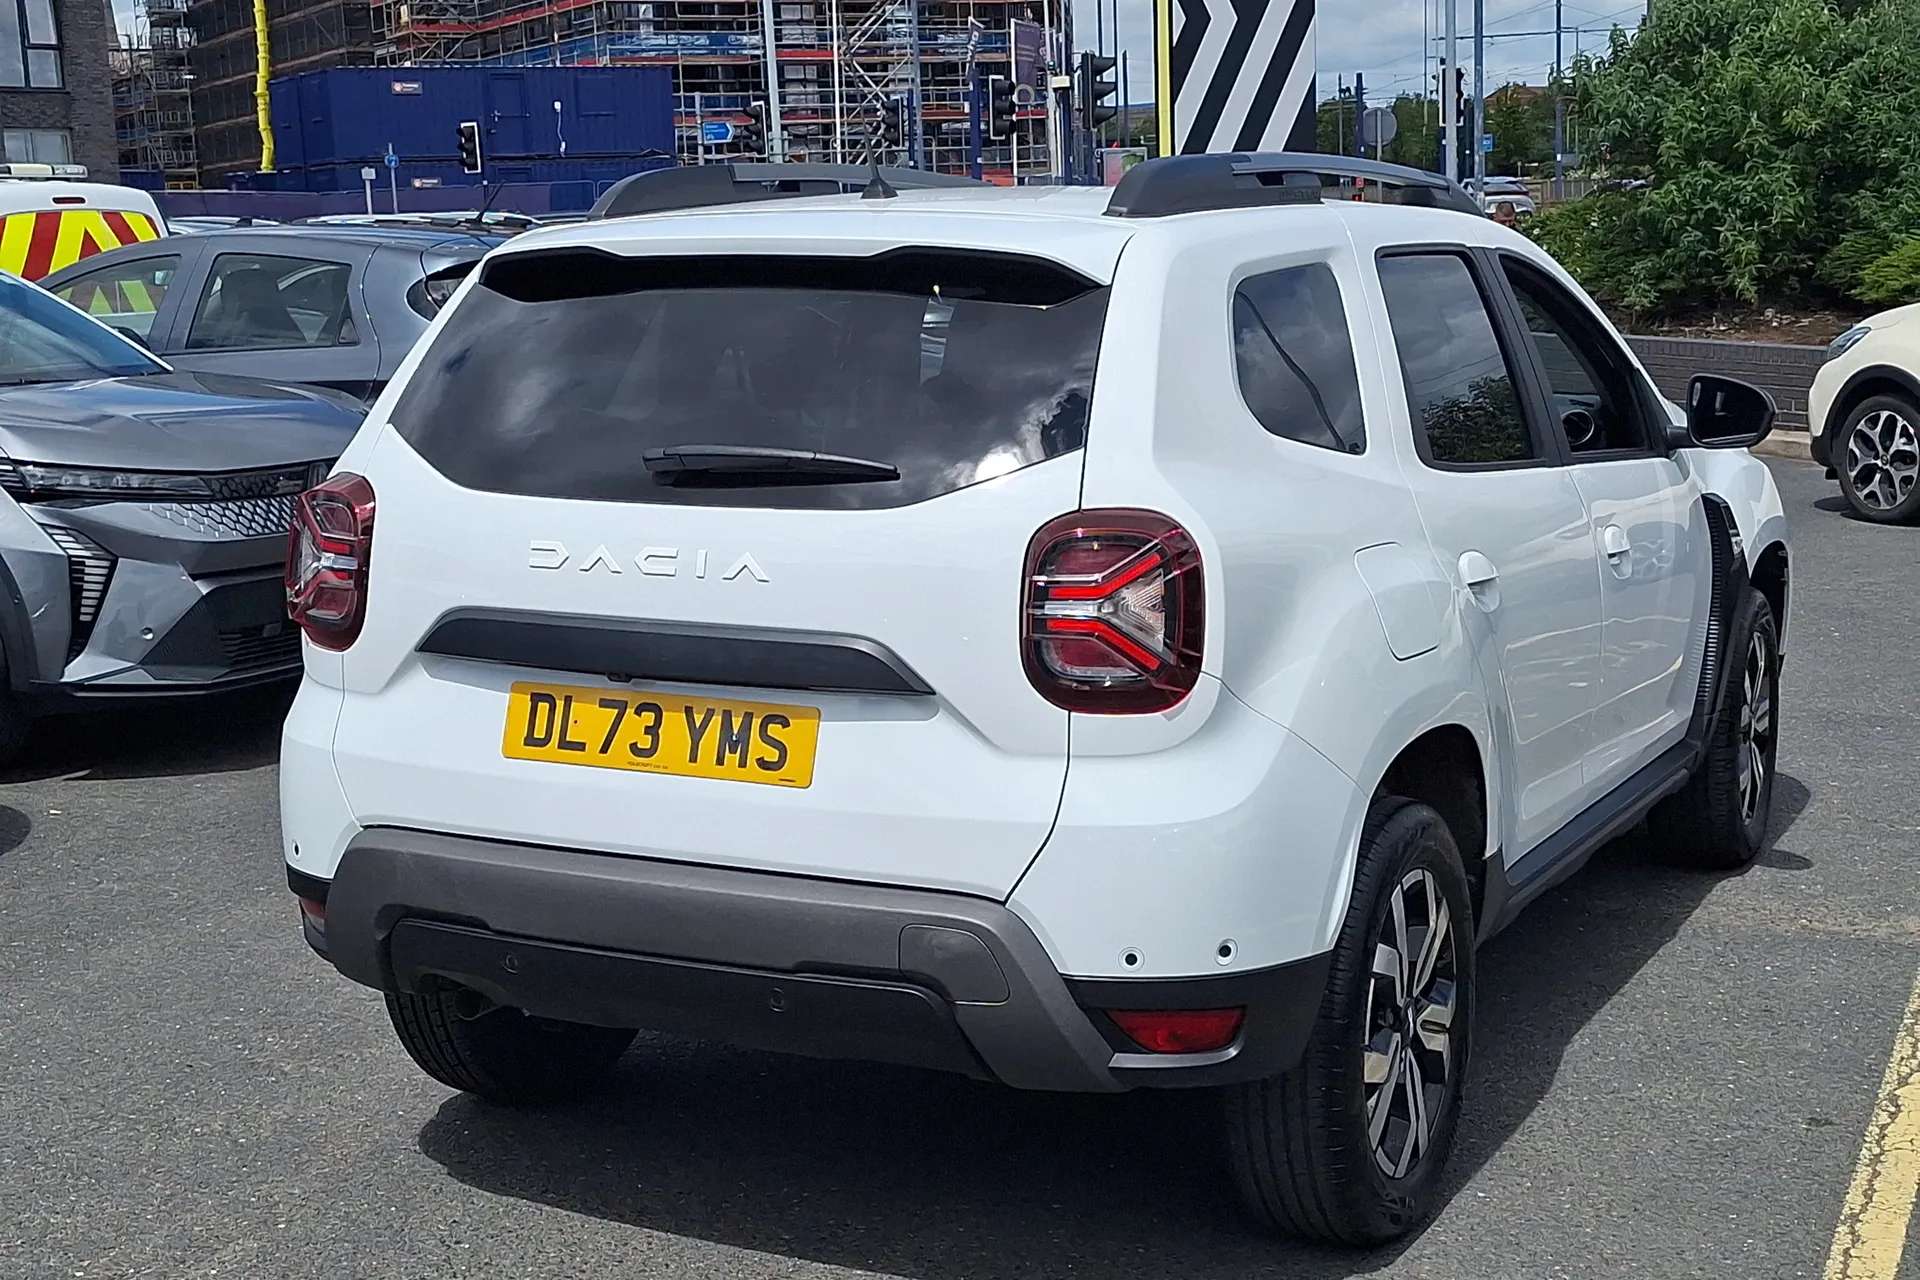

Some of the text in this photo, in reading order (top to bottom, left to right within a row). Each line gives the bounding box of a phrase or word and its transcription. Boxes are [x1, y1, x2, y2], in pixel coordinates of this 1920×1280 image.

[528, 540, 770, 583] DACIA
[523, 691, 792, 773] DL73 YMS
